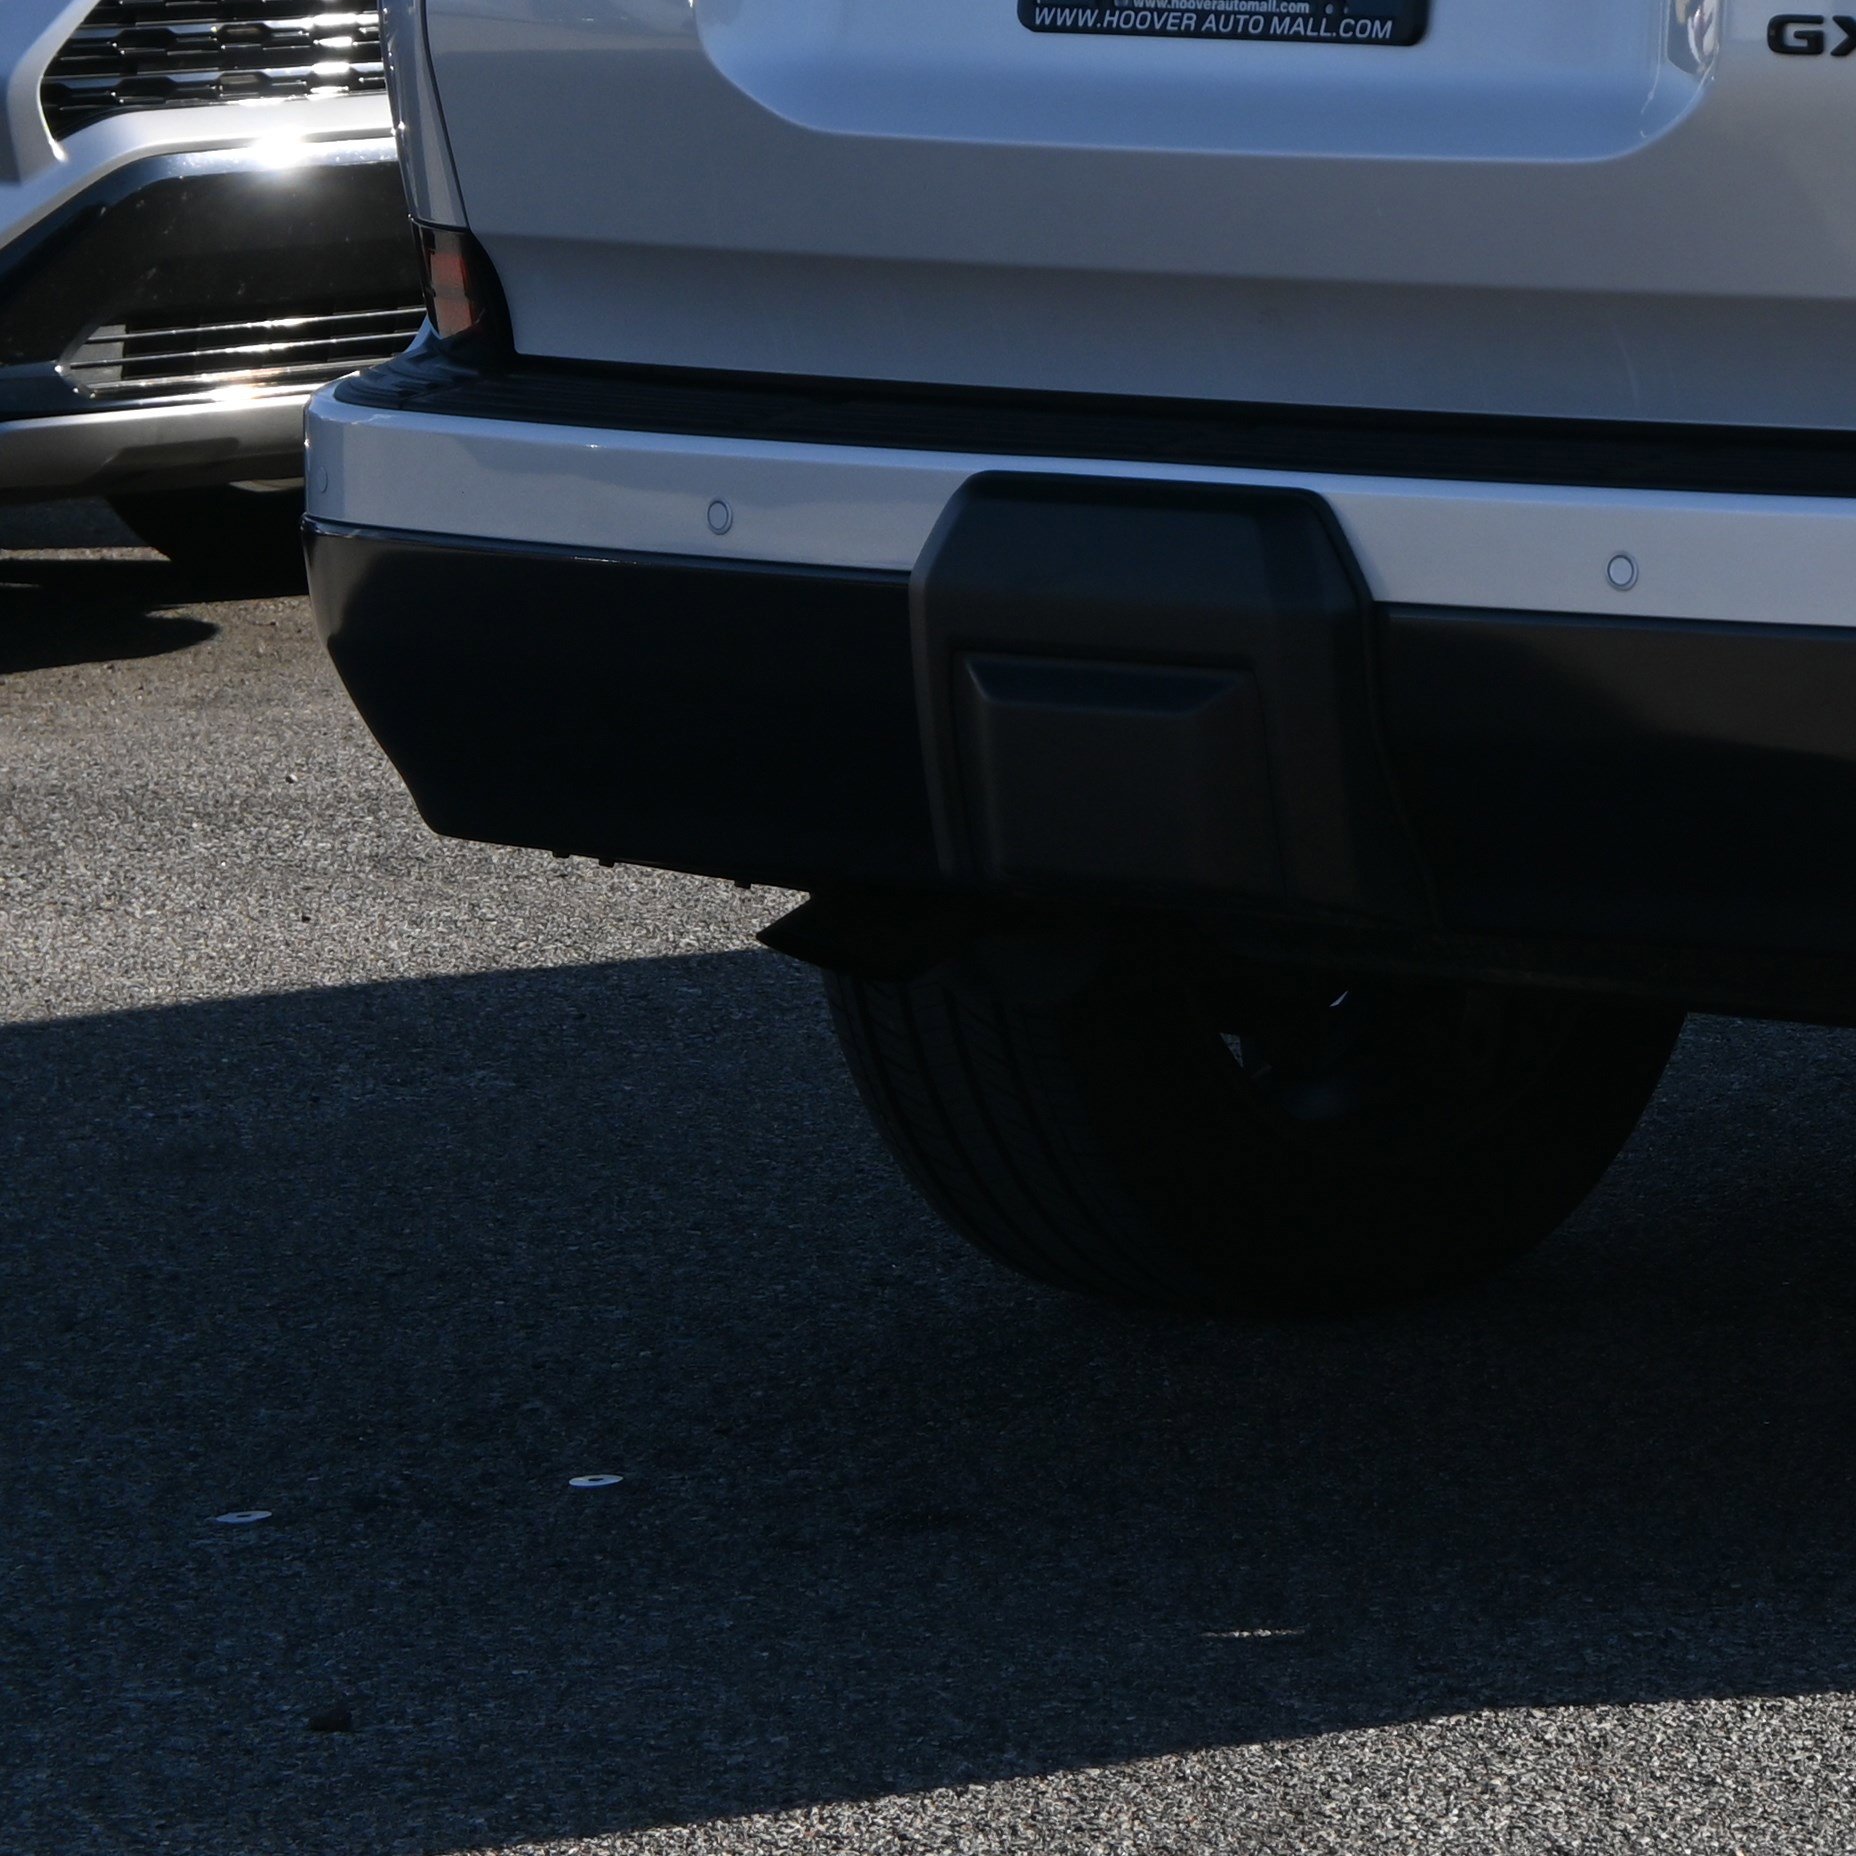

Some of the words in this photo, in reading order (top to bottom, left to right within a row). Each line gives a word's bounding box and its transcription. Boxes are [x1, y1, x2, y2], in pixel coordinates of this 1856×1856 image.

[1033, 6, 1197, 32] WWW.HOOVER
[1200, 14, 1265, 34] AUTO
[1269, 16, 1394, 40] MALL.COM
